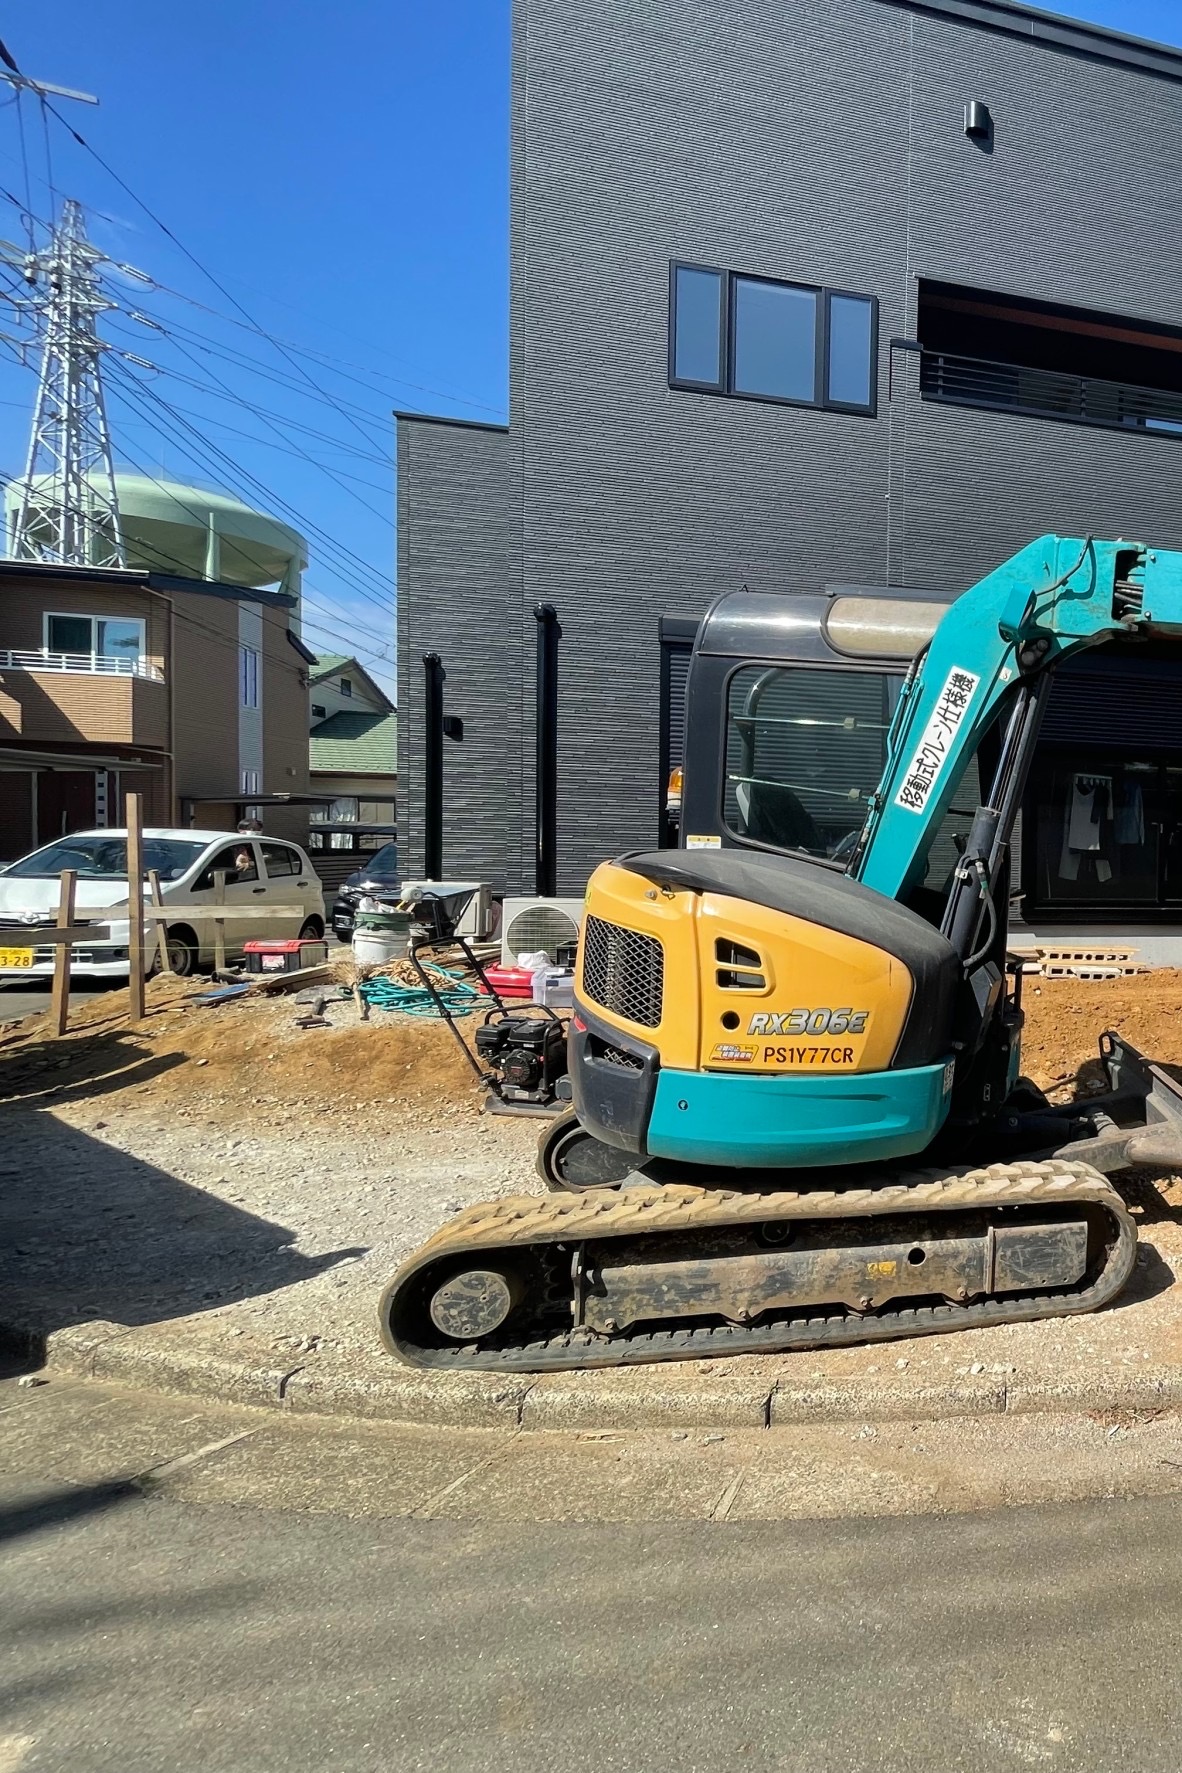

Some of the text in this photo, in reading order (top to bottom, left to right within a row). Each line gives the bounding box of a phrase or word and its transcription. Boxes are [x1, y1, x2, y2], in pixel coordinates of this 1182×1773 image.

[900, 673, 976, 809] 移動式クレーン仕様機
[747, 1008, 870, 1036] RX306E
[763, 1046, 854, 1064] PS1Y77CR
